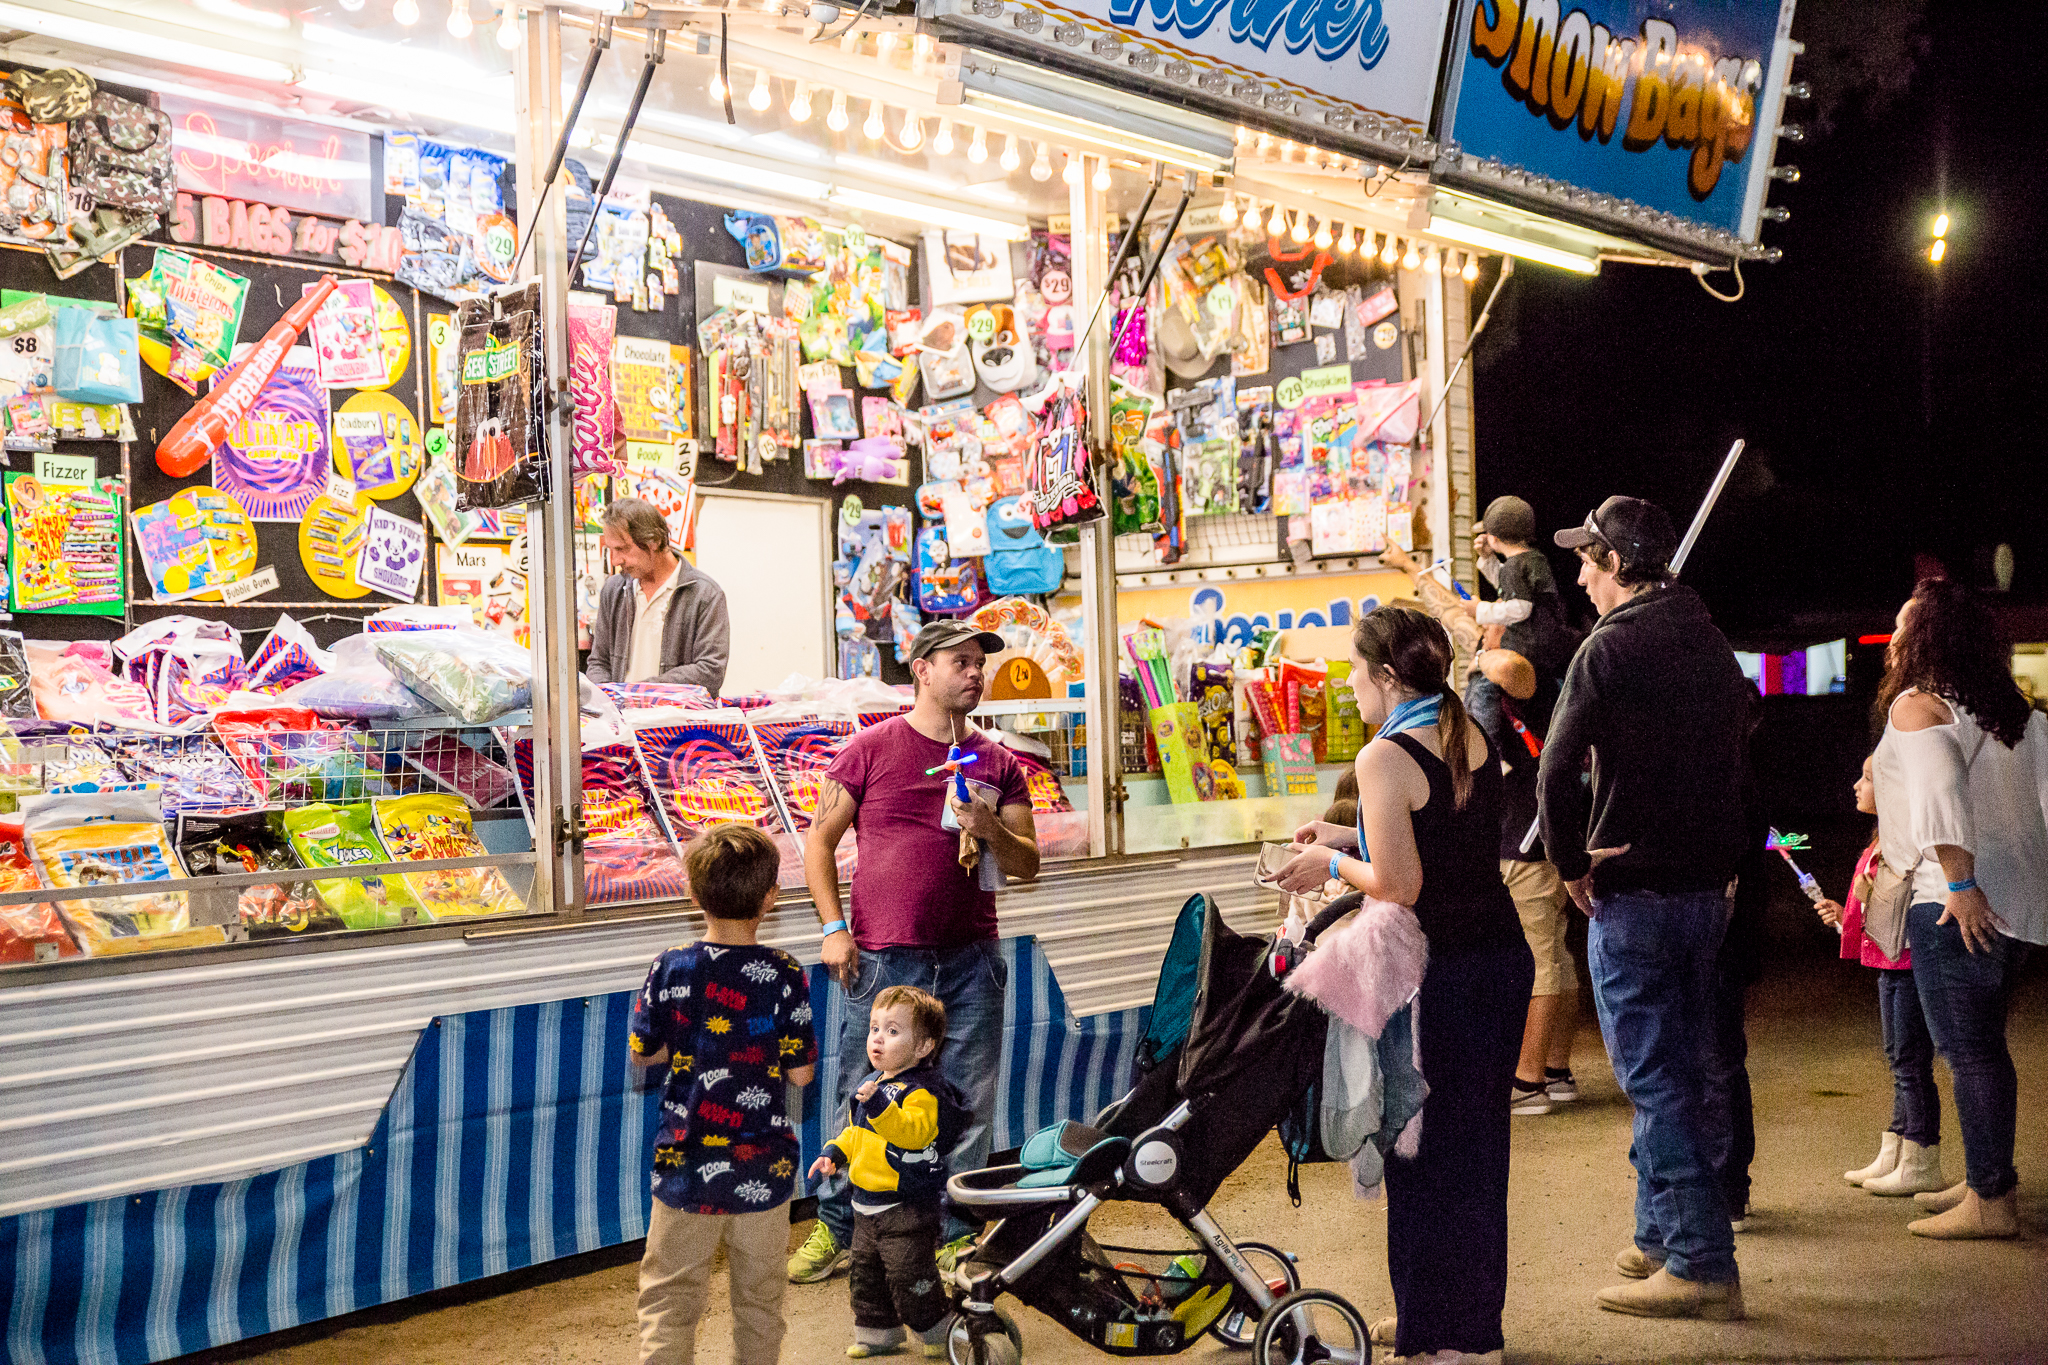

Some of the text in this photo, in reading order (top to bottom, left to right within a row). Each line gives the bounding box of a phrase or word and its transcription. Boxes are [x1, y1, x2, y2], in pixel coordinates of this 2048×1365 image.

[68, 192, 93, 212] $18
[170, 193, 403, 274] 5 BAGS for $10
[489, 232, 513, 255] $29
[204, 272, 228, 293] Chips
[1044, 276, 1070, 294] $29
[434, 326, 446, 345] 3
[970, 317, 994, 334] $29
[14, 336, 38, 354] $8
[624, 345, 666, 363] Chocolate
[488, 347, 517, 374] STREET
[1279, 382, 1304, 402] $29
[340, 417, 377, 430] Cadbury
[228, 418, 325, 453] ULTIMATE
[637, 447, 663, 464] Goody
[43, 461, 89, 481] Fizzer
[332, 484, 350, 499] Fizz
[845, 500, 862, 519] $29
[373, 517, 423, 544] KID'S STUFF
[456, 552, 487, 568] Mars
[373, 566, 409, 589] SHOWBAG
[225, 576, 272, 600] Bubble Gum
[674, 784, 767, 823] ULTIMATE
[659, 985, 692, 1003] KA-BOOM
[698, 1067, 734, 1091] ZOOM
[696, 1160, 735, 1184] ZOOM
[1140, 1157, 1173, 1167] Steelcraft
[1212, 1234, 1247, 1274] Agile Plus
